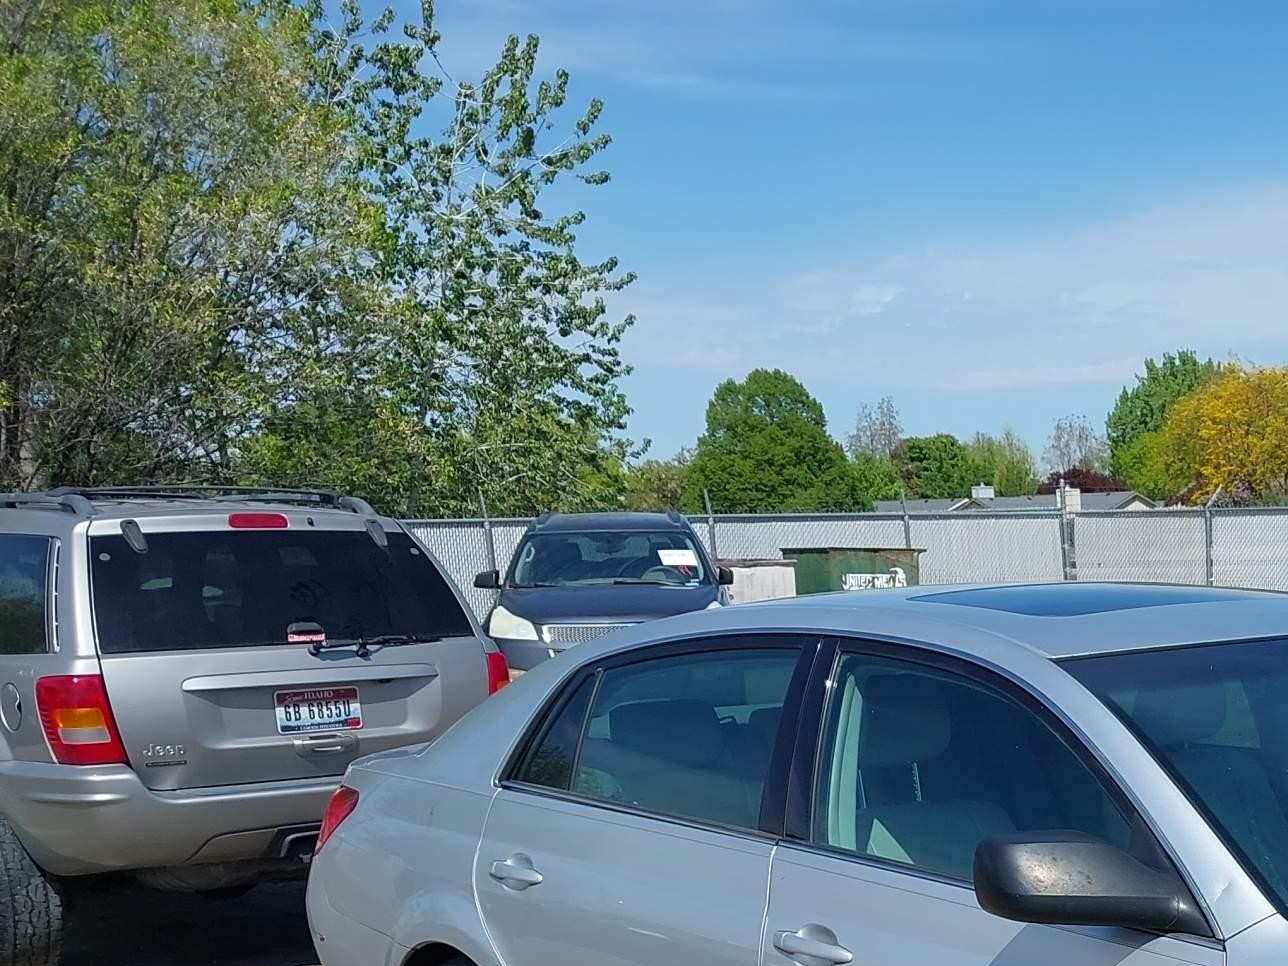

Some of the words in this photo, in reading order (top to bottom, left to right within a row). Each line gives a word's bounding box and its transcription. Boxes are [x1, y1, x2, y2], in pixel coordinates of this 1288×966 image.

[304, 690, 334, 699] IDAHO
[284, 703, 302, 722] 6B
[308, 699, 351, 720] 6855U
[143, 743, 185, 758] Jeep
